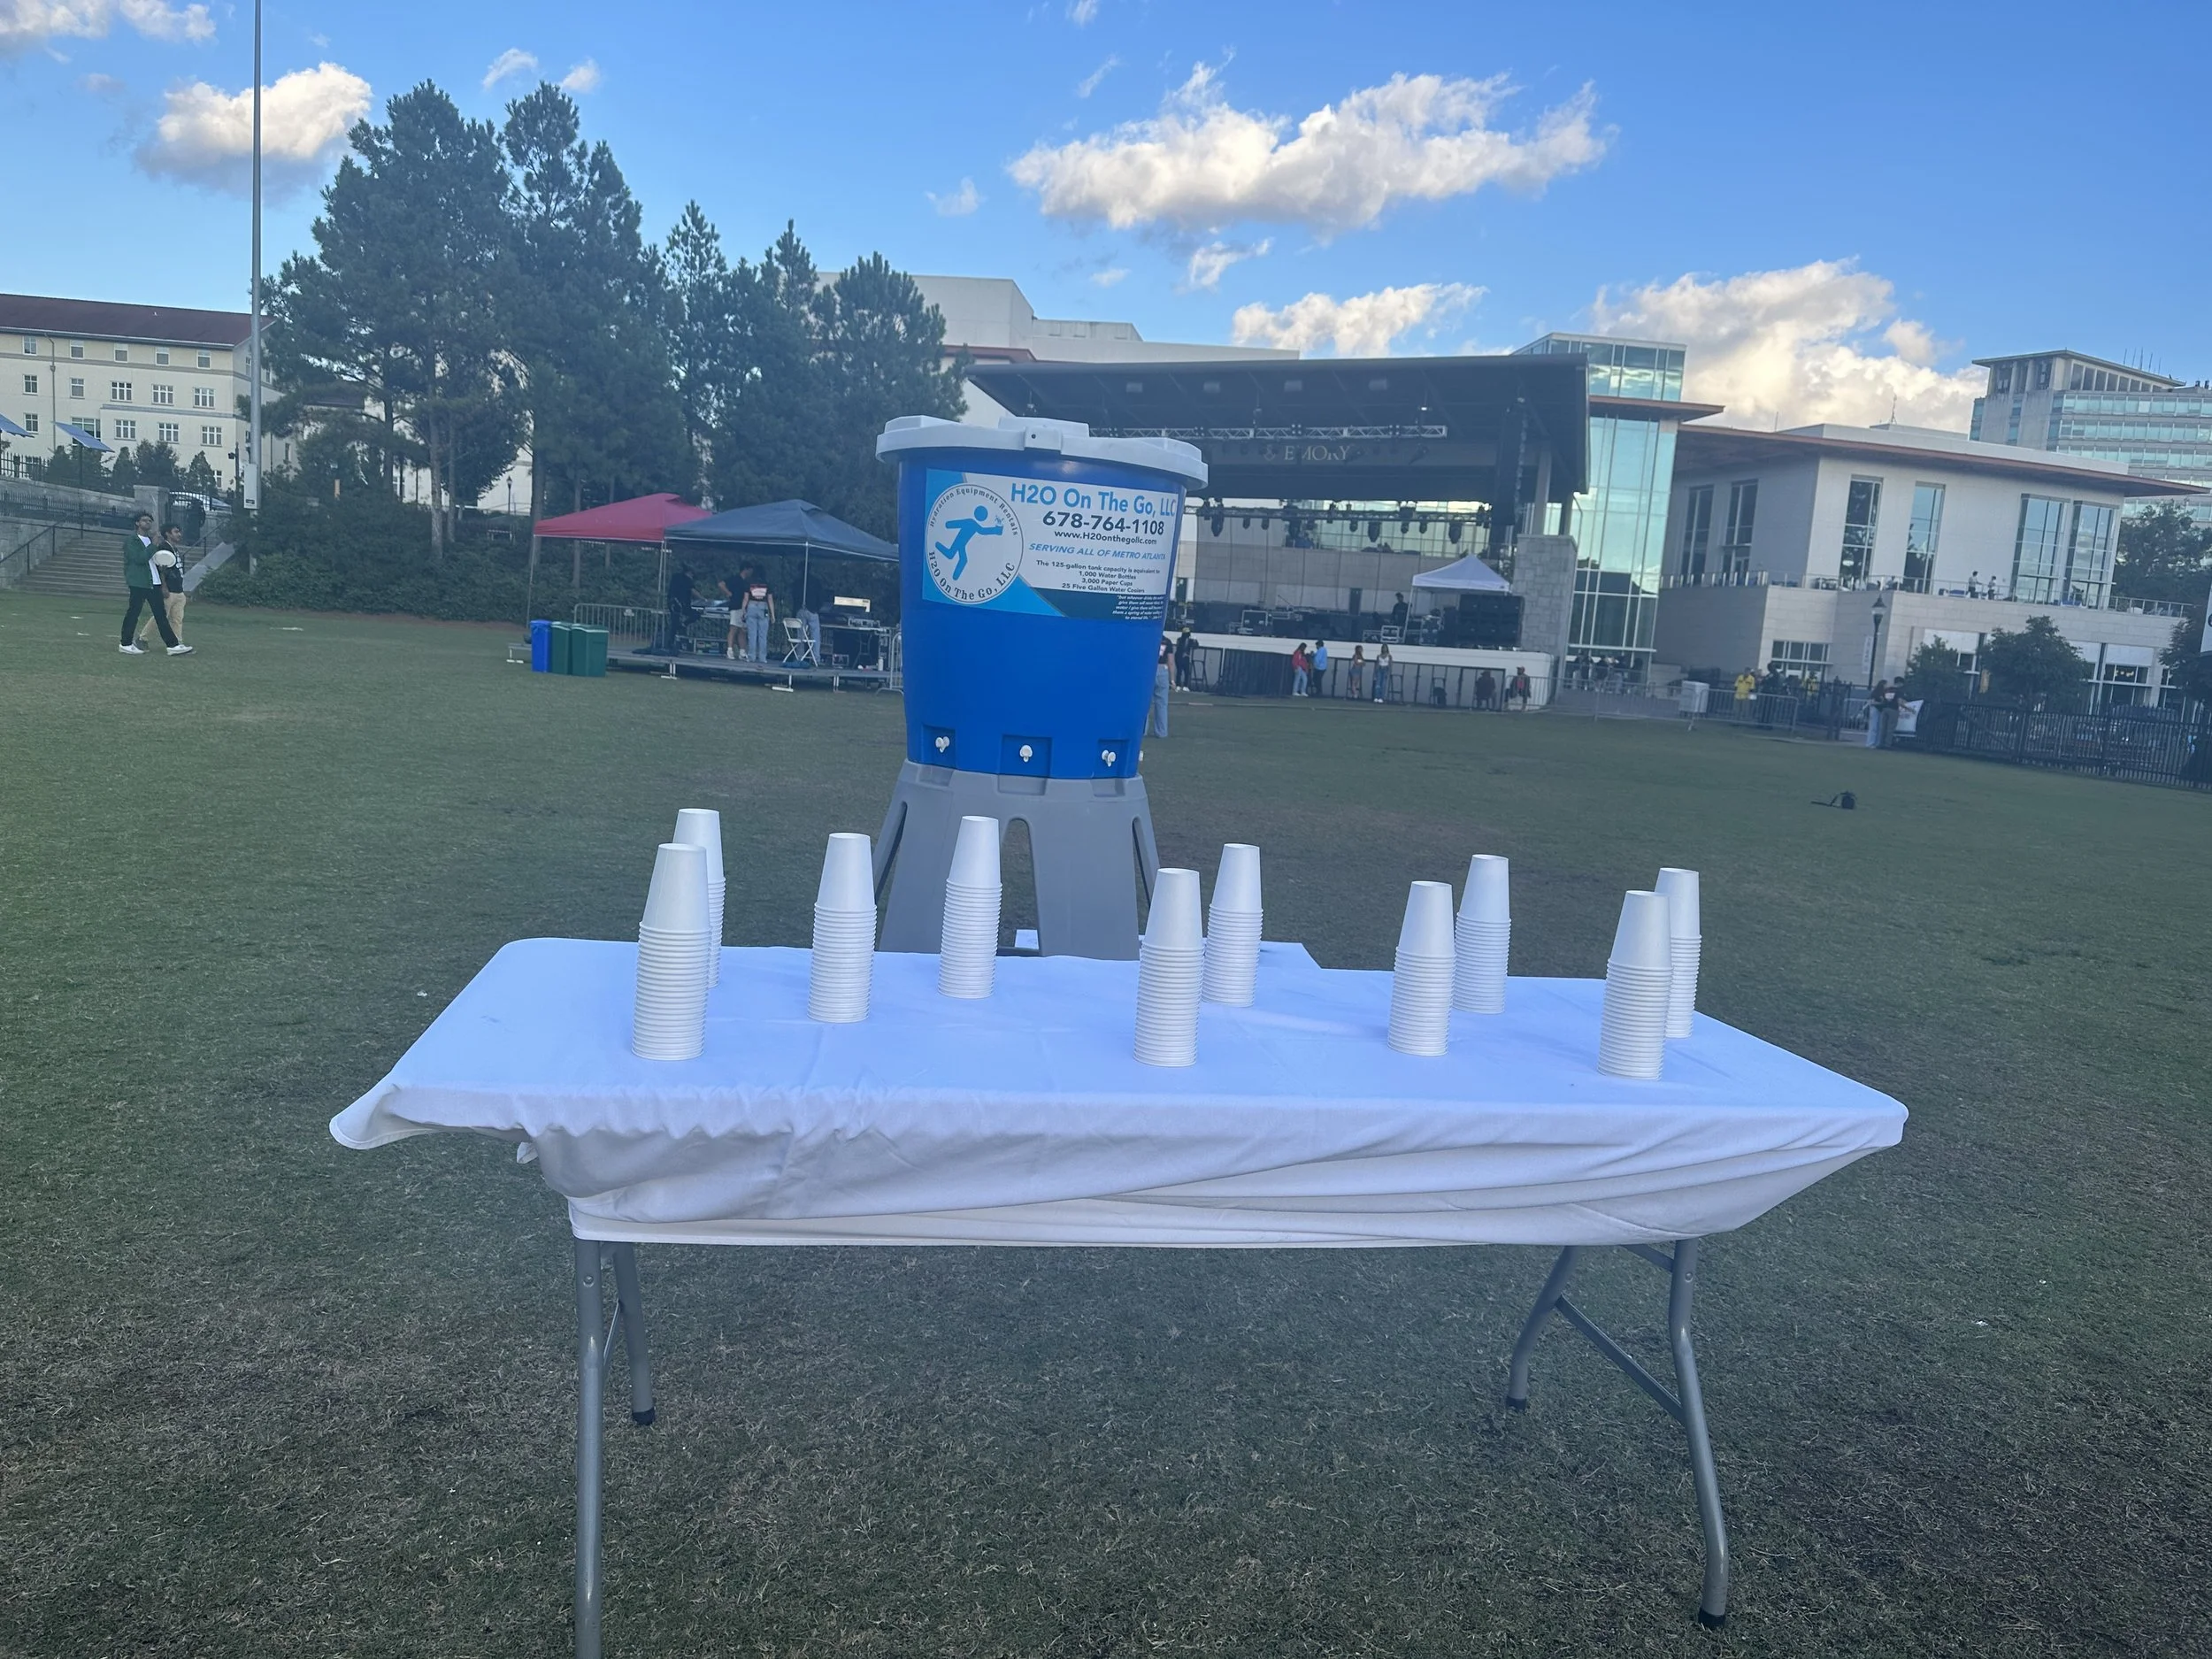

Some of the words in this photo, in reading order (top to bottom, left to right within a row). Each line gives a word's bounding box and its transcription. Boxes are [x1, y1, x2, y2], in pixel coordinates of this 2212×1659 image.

[930, 492, 955, 527] Hydration
[956, 488, 998, 503] Equipment
[999, 503, 1018, 535] Rentals
[1011, 483, 1056, 505] H2O
[1064, 488, 1091, 509] On
[1098, 491, 1128, 512] The
[1133, 495, 1156, 518] Go,
[1160, 497, 1176, 517] LLC
[1042, 511, 1164, 535] 678-764-1108
[1029, 542, 1075, 554] SERVING
[1076, 547, 1094, 557] ALL
[1097, 549, 1111, 557] OF
[1112, 550, 1141, 560] METRO
[1141, 552, 1166, 561] ATLANTA
[1052, 561, 1087, 570] 125-gallon
[940, 578, 952, 594] On
[954, 588, 975, 600] The
[978, 588, 998, 598] Go,
[995, 563, 1015, 587] LLC
